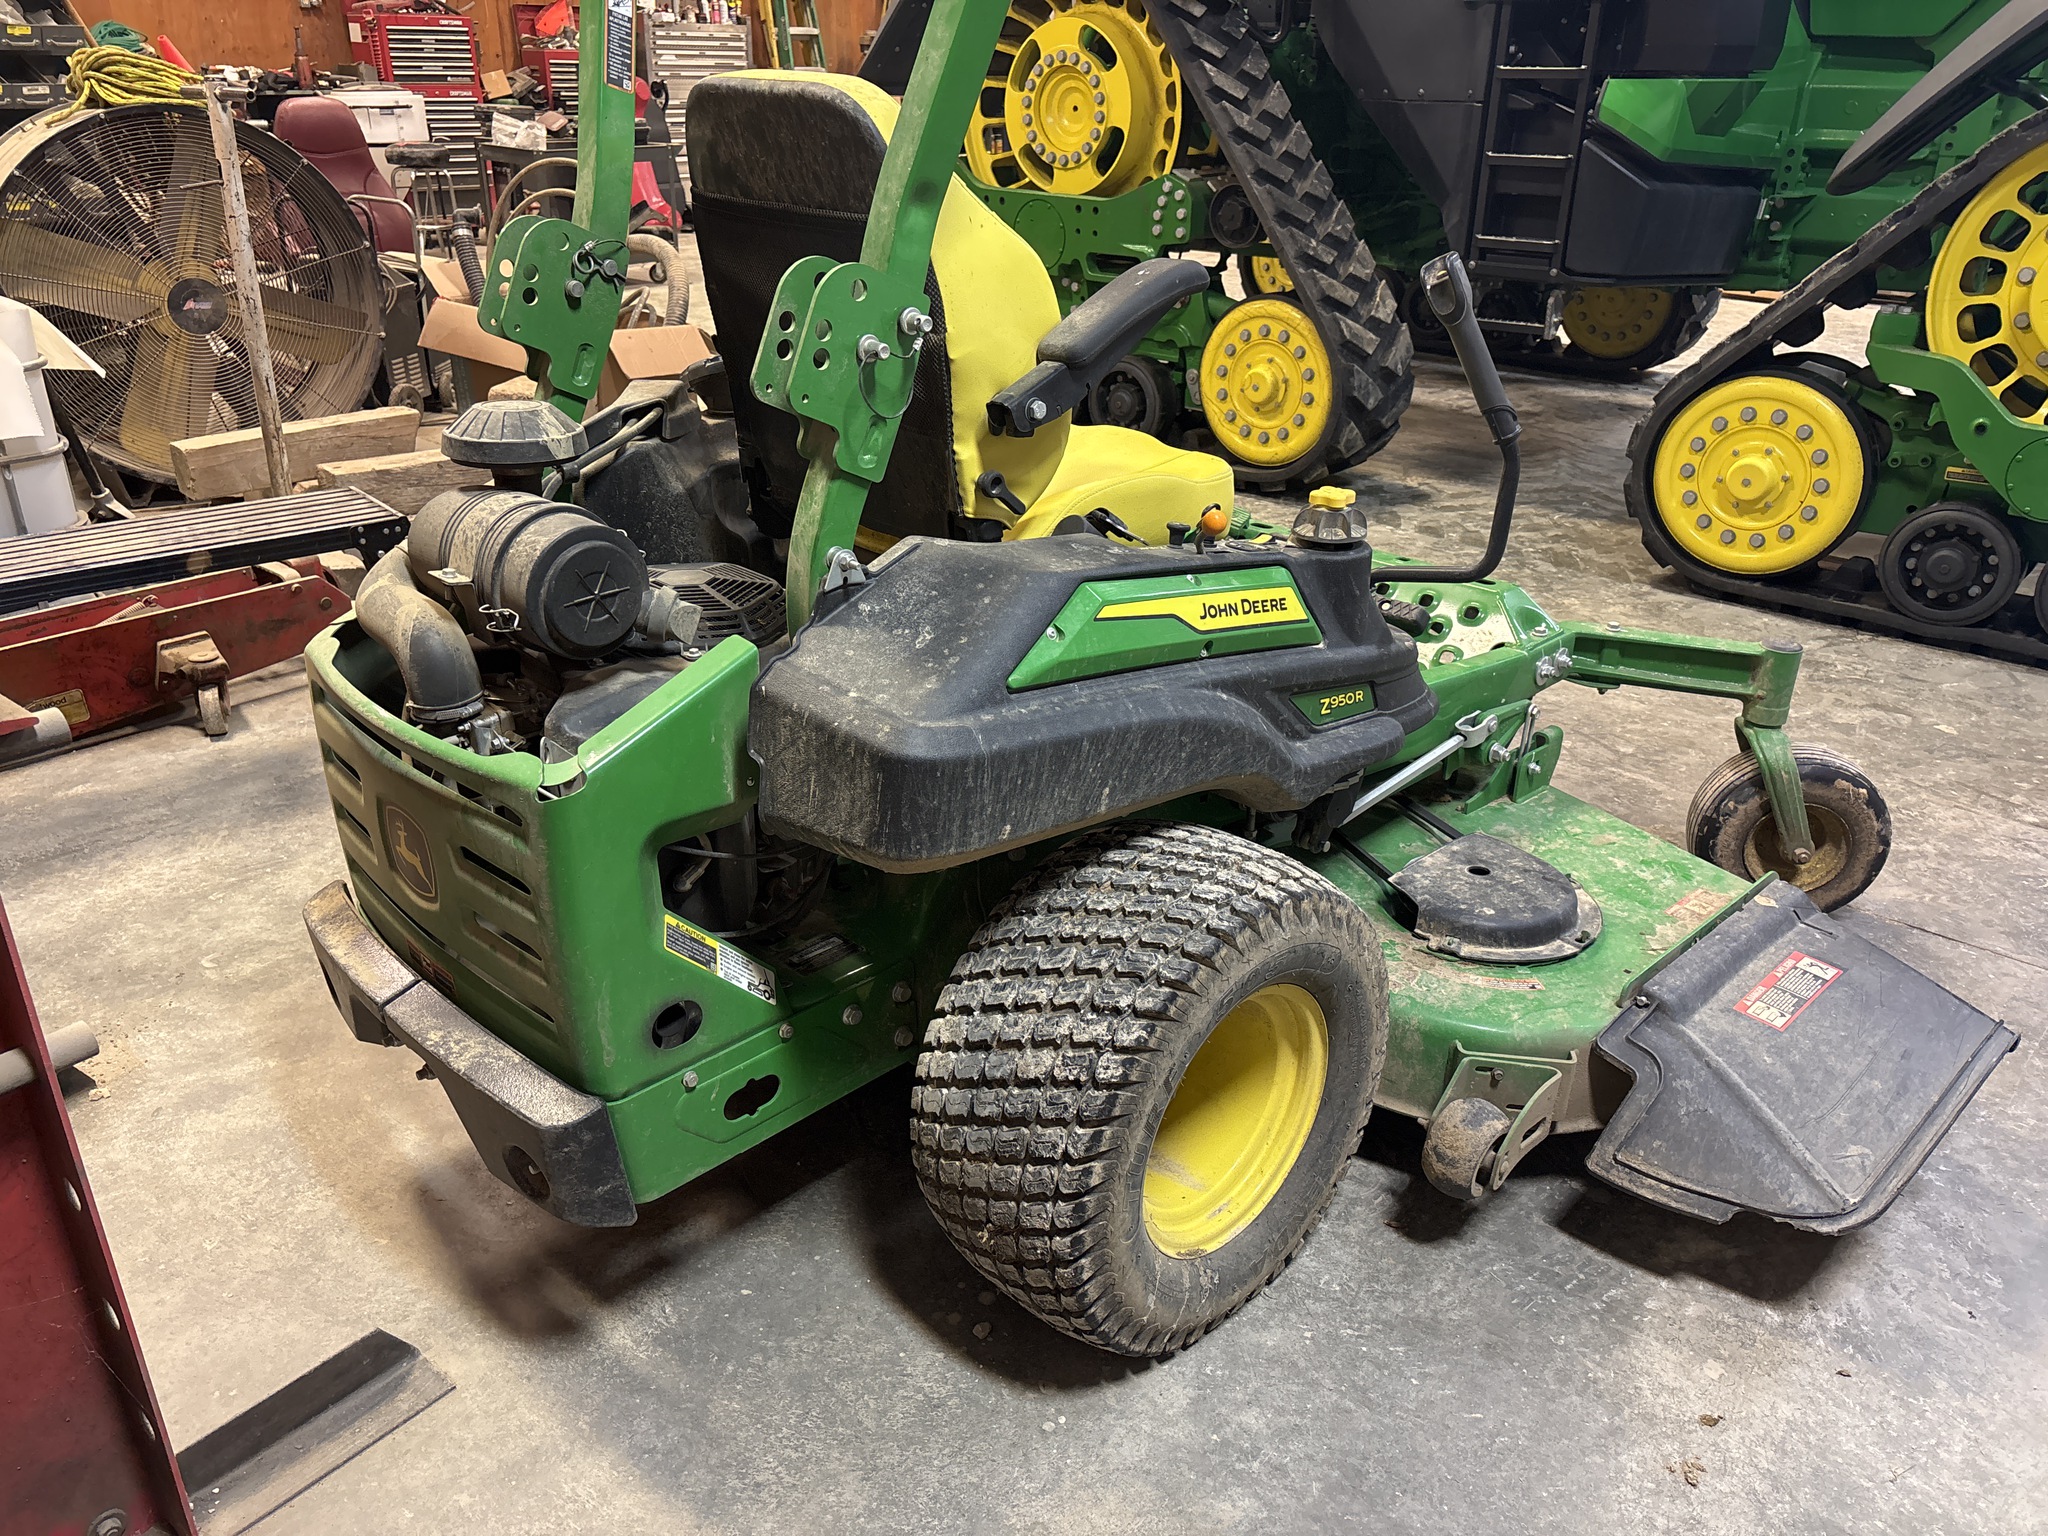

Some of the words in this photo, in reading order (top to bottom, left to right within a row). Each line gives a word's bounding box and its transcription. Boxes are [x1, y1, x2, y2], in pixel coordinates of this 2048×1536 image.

[1199, 601, 1239, 620] JOHN
[1241, 597, 1288, 615] DEERE
[680, 924, 706, 943] CAUTION
